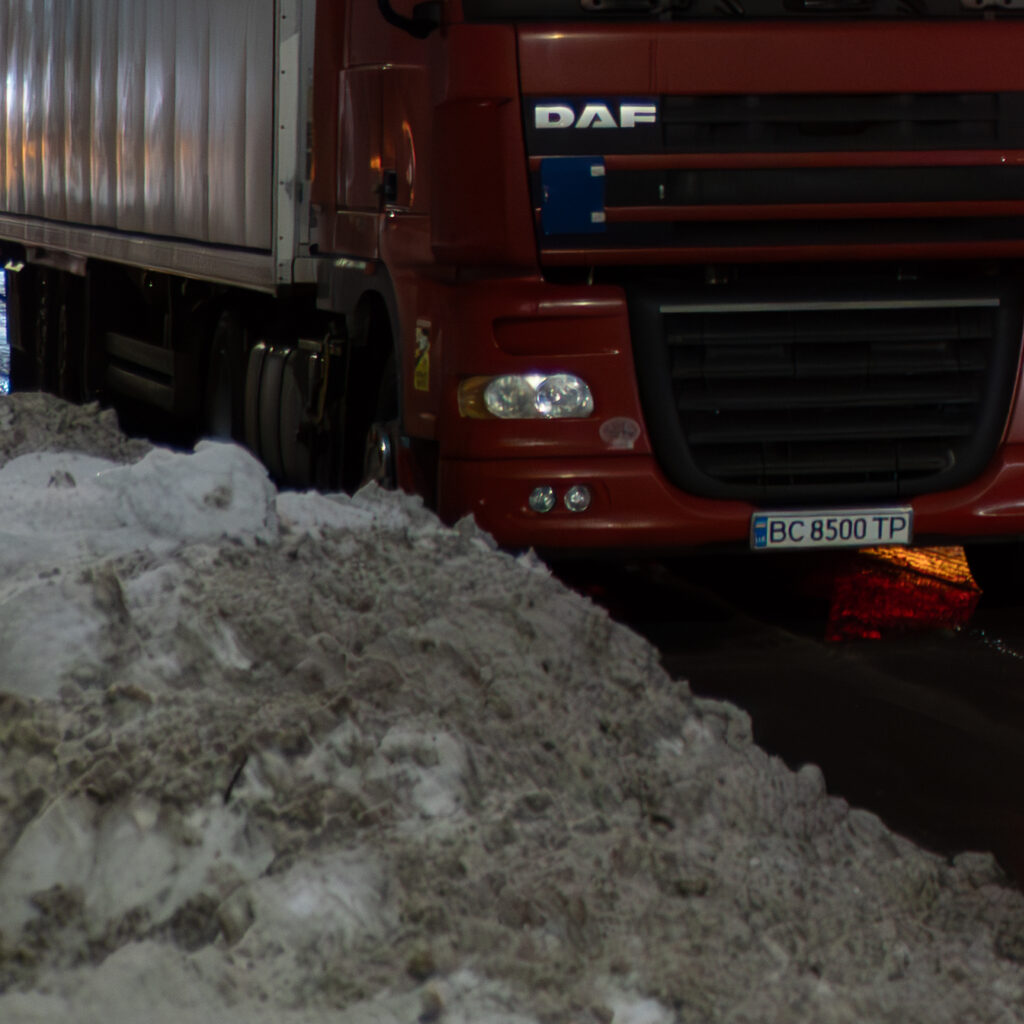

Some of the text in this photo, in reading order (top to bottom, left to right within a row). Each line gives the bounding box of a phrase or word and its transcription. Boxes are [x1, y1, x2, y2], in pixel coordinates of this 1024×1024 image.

[534, 103, 657, 130] DAF
[770, 520, 805, 543] BC
[810, 518, 867, 541] 8500
[872, 516, 906, 539] TP
